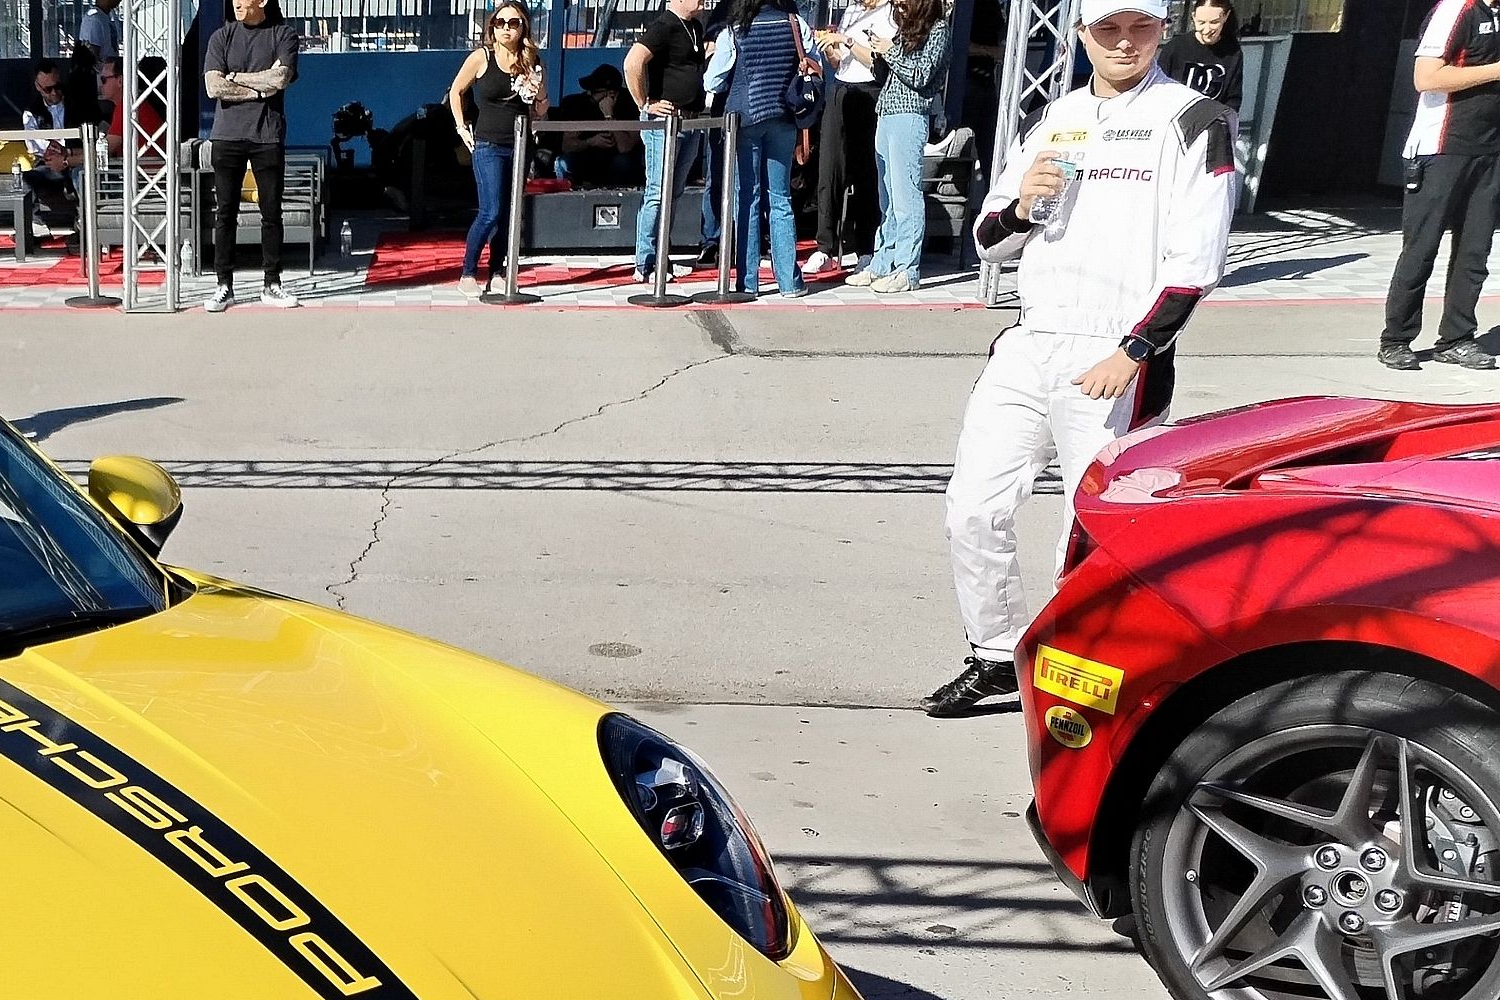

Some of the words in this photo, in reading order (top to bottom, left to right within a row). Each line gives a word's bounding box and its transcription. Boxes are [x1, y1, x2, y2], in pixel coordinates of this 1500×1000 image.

[1088, 168, 1153, 181] RACING
[1041, 656, 1113, 700] PIRELLI
[1050, 716, 1086, 737] PENNZOIL
